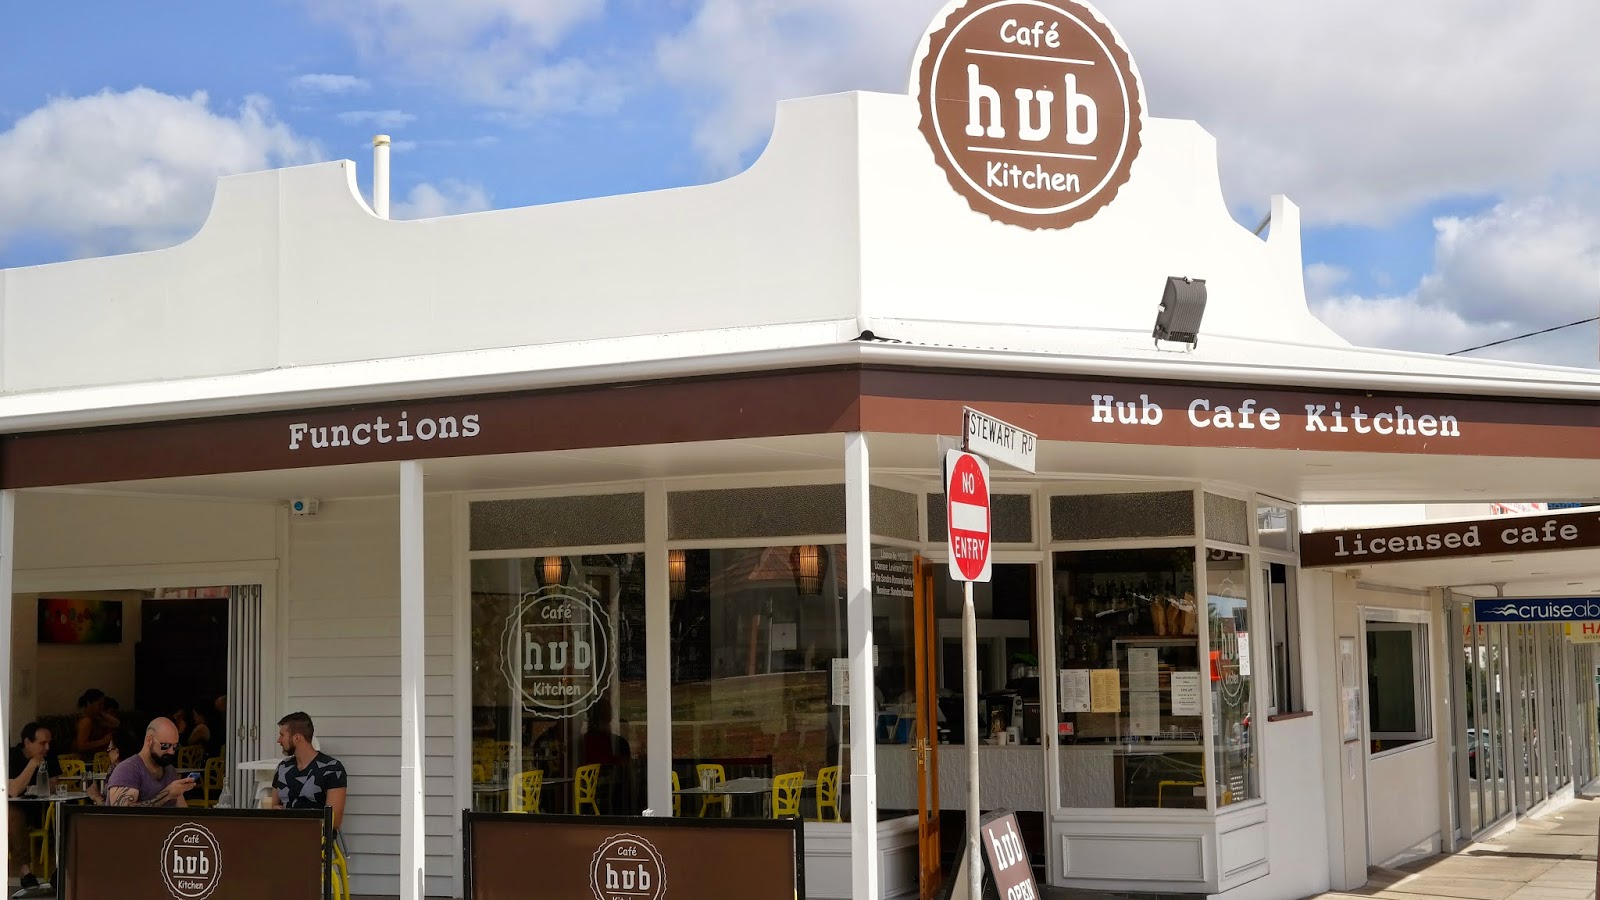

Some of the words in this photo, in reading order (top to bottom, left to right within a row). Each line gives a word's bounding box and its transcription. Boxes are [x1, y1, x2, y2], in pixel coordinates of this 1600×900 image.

[1000, 19, 1060, 48] Café
[965, 63, 1098, 145] hub
[986, 161, 1080, 193] Kitchen
[1091, 394, 1163, 426] Hub
[1187, 398, 1281, 431] Cafe
[1305, 401, 1461, 438] Kitchen
[288, 411, 481, 450] Functions
[969, 413, 1016, 450] STEWART
[961, 472, 975, 495] NO
[955, 536, 985, 561] ENTRY
[1334, 525, 1481, 557] licensed
[1500, 520, 1578, 544] cafe
[541, 603, 572, 620] Café
[523, 630, 591, 671] hub
[533, 681, 581, 697] Kitchen
[182, 834, 200, 844] Café
[617, 845, 638, 857] Café
[988, 821, 1023, 871] hub
[173, 849, 210, 875] hub
[605, 862, 651, 890] hub
[178, 880, 204, 890] Kitchen
